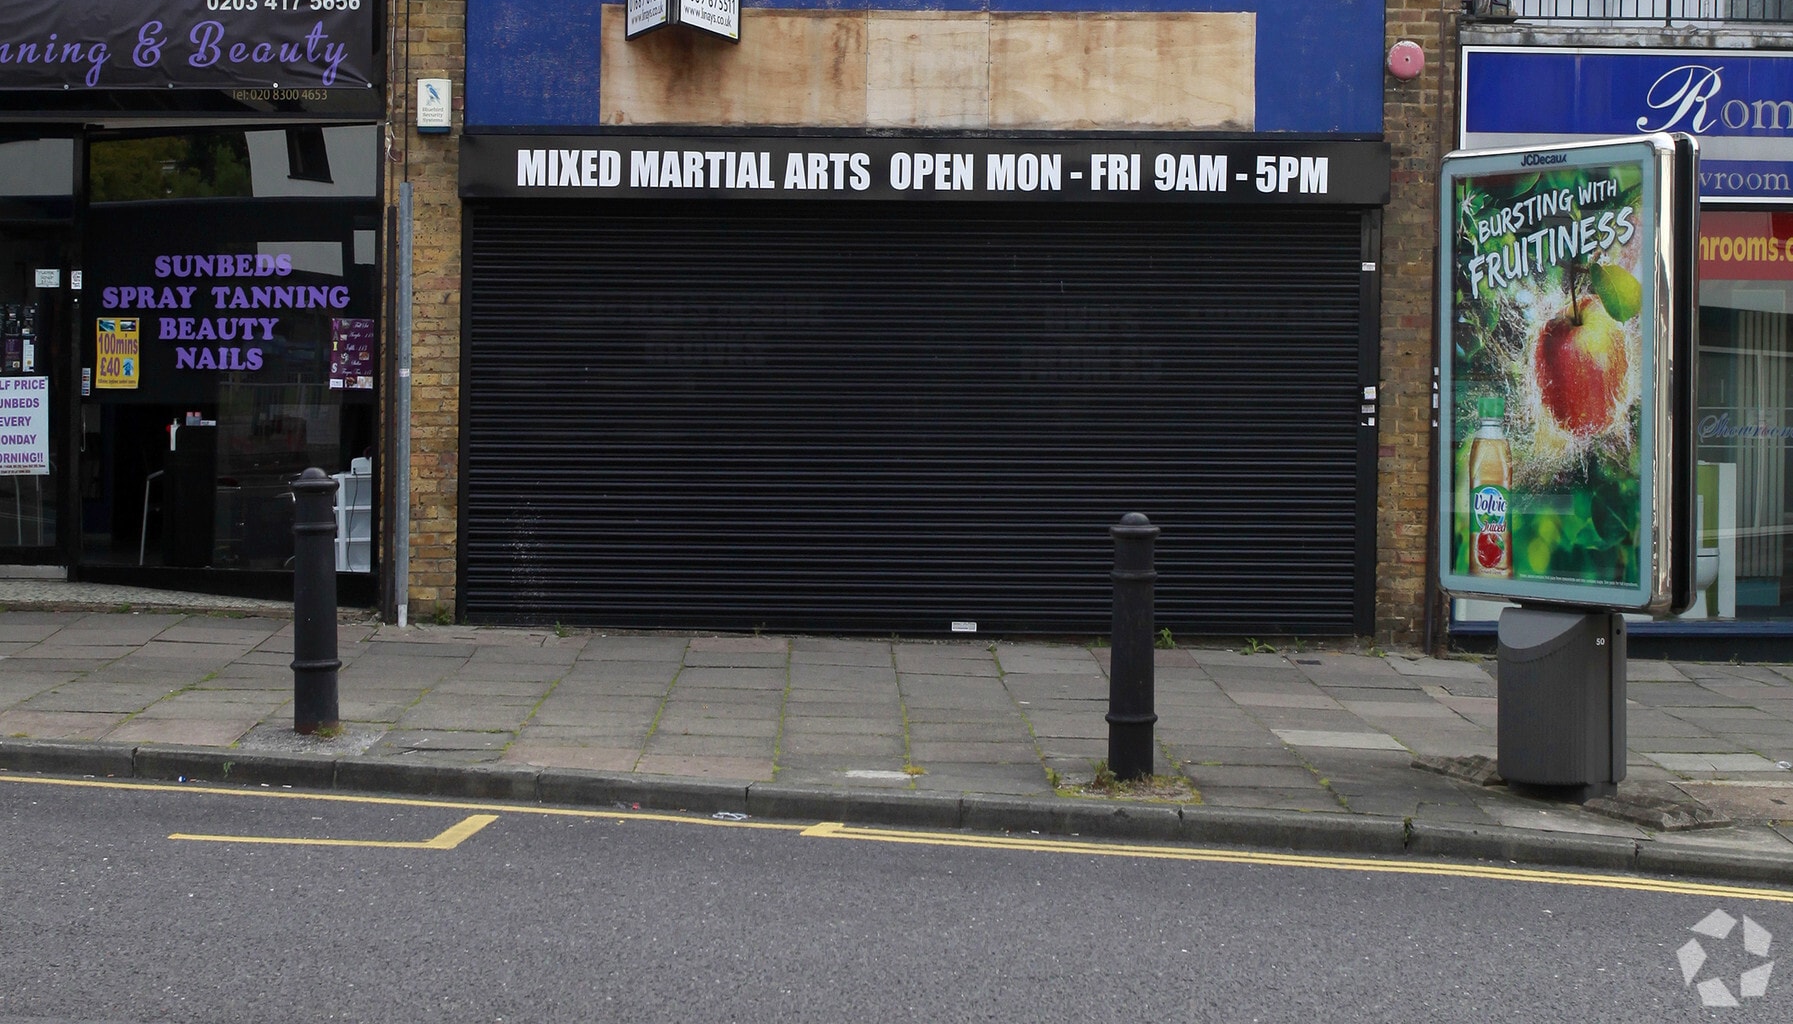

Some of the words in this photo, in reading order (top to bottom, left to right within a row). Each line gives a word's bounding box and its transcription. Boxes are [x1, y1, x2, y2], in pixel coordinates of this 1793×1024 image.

[684, 5, 732, 28] www.linays.co.uk
[132, 20, 167, 68] &
[188, 20, 348, 86] Beauty
[250, 89, 271, 101] 020
[272, 89, 300, 101] 8300
[302, 89, 328, 101] 4653
[1636, 64, 1793, 133] Rom
[517, 149, 621, 187] MIXED
[630, 150, 775, 189] MARTIAL
[784, 152, 871, 191] ARTS
[889, 152, 974, 191] OPEN
[986, 153, 1062, 191] MON
[1091, 153, 1140, 191] FRI
[1154, 153, 1227, 192] 9AM
[1255, 155, 1329, 194] 5PM
[1520, 153, 1567, 167] JCDecaux
[1478, 188, 1574, 244] BURSTING
[1578, 178, 1617, 206] WITH
[1468, 206, 1635, 300] FRUITINESS
[155, 254, 292, 277] SUNBEDS
[102, 286, 197, 309] SPRAY
[211, 286, 350, 309] TANNING
[158, 317, 279, 340] BEAUTY
[99, 333, 138, 354] 100mins
[100, 357, 120, 376] £40
[175, 347, 263, 370] NAILS
[14, 379, 45, 390] PRICE
[1474, 493, 1507, 514] Volvic
[1481, 520, 1507, 533] Juiced
